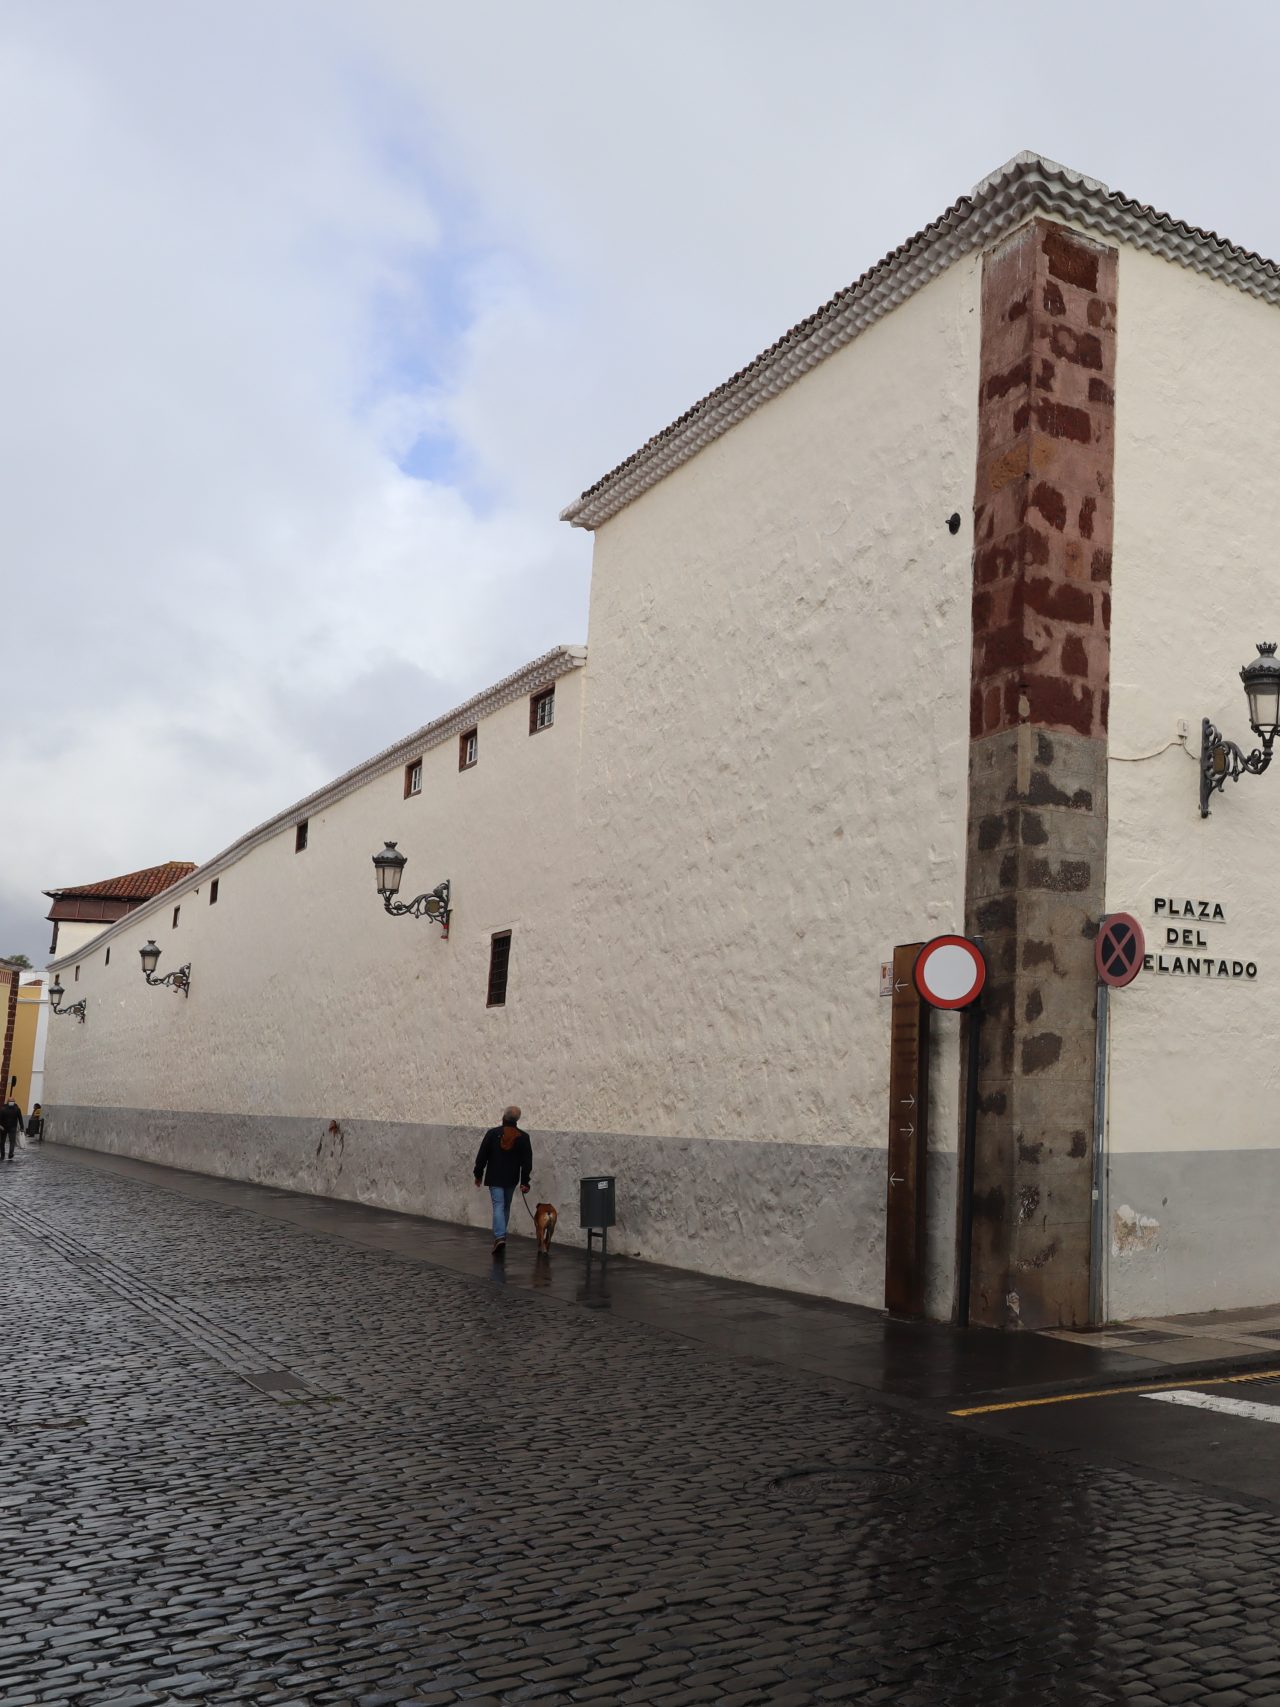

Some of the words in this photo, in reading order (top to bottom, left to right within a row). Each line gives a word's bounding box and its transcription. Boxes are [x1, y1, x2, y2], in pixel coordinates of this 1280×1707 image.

[1154, 897, 1225, 919] PLAZA
[1166, 927, 1207, 946] DEL
[1143, 954, 1258, 978] ELANTADO
